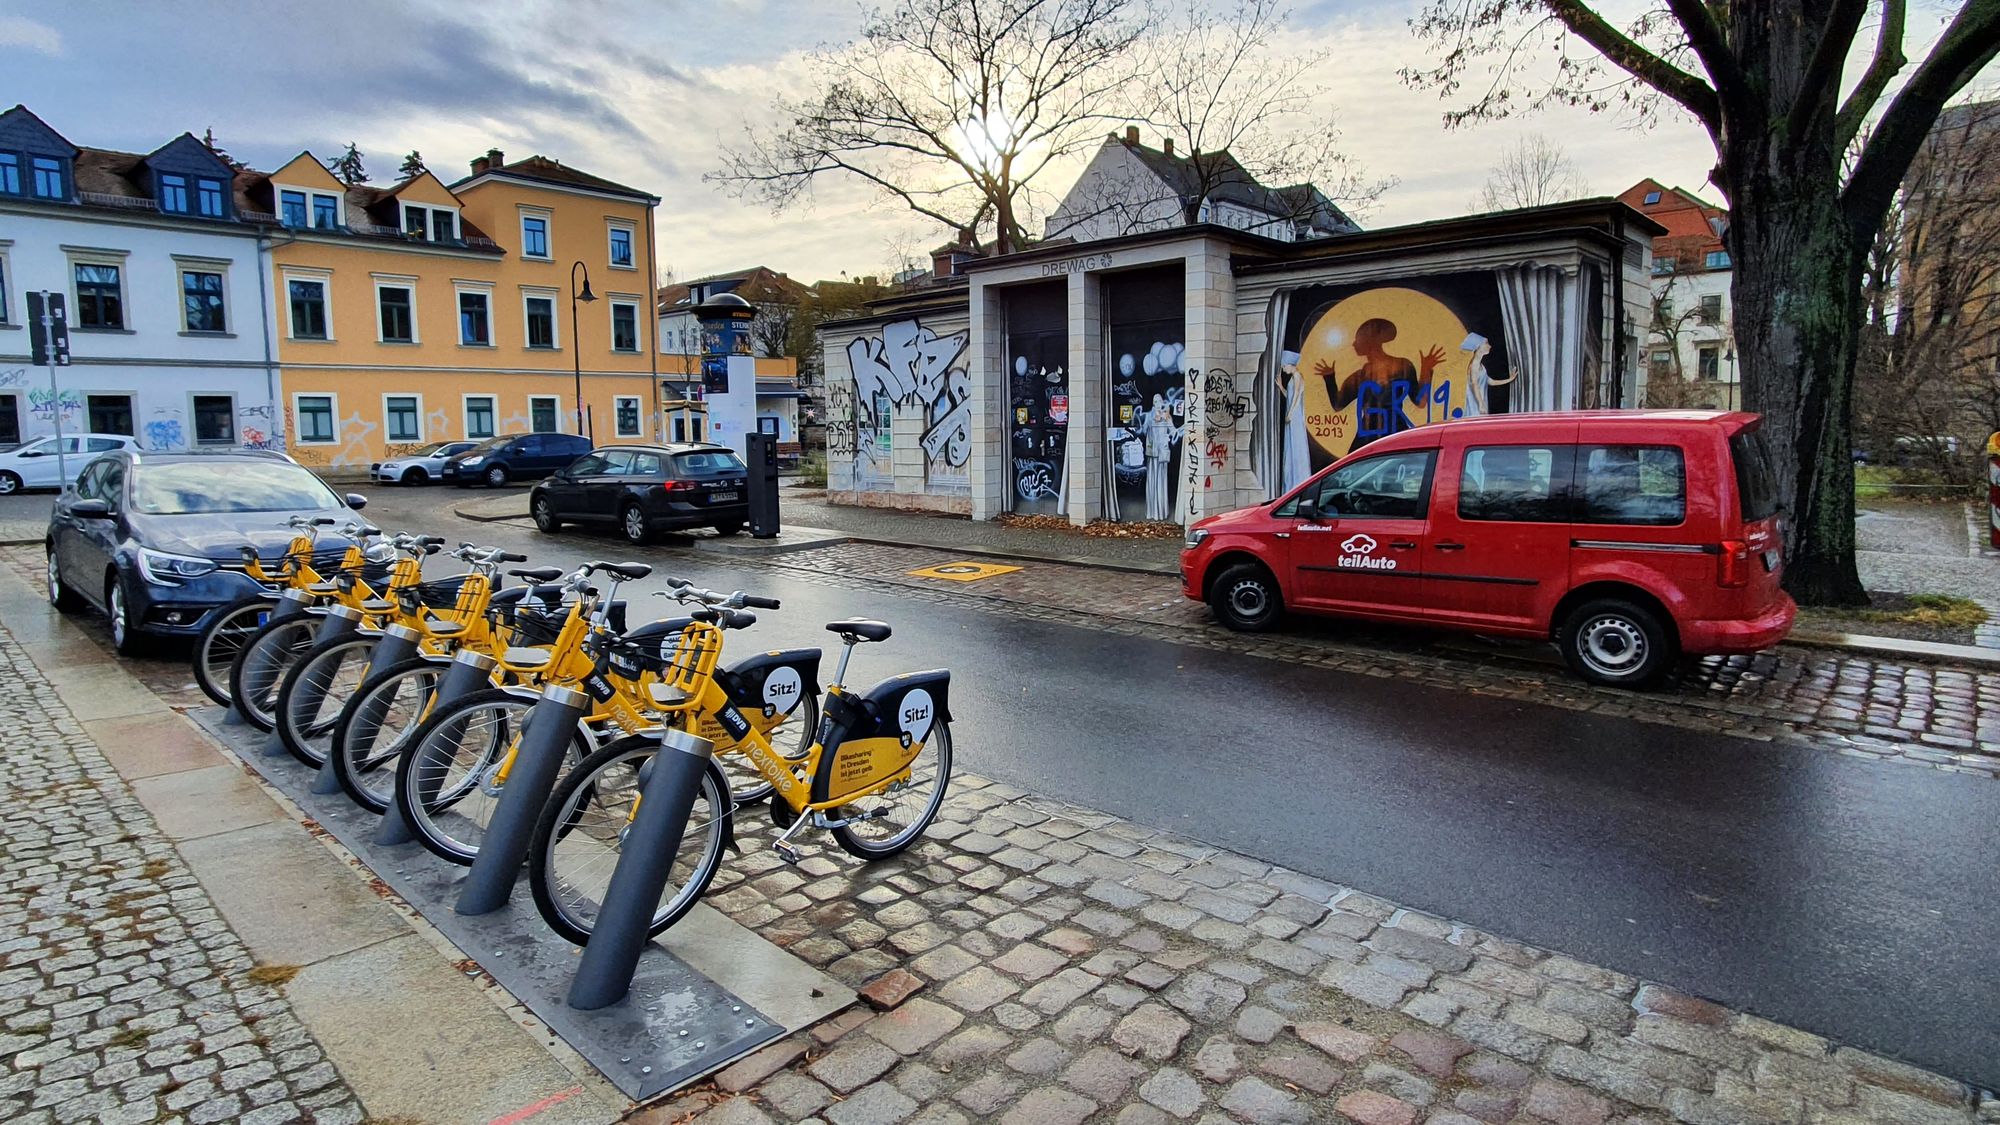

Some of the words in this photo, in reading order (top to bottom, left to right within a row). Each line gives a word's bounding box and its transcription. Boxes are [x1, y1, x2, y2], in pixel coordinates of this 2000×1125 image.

[1042, 257, 1095, 276] DREWAG
[1315, 426, 1344, 438] 2013
[1338, 554, 1397, 570] teilAuto
[769, 681, 796, 697] Sitz!
[731, 713, 747, 731] DVB
[904, 704, 929, 724] Sitz!
[744, 740, 793, 791] nextbike
[847, 759, 870, 768] Dresden
[848, 768, 861, 777] jetzt
[861, 765, 873, 774] gelb
